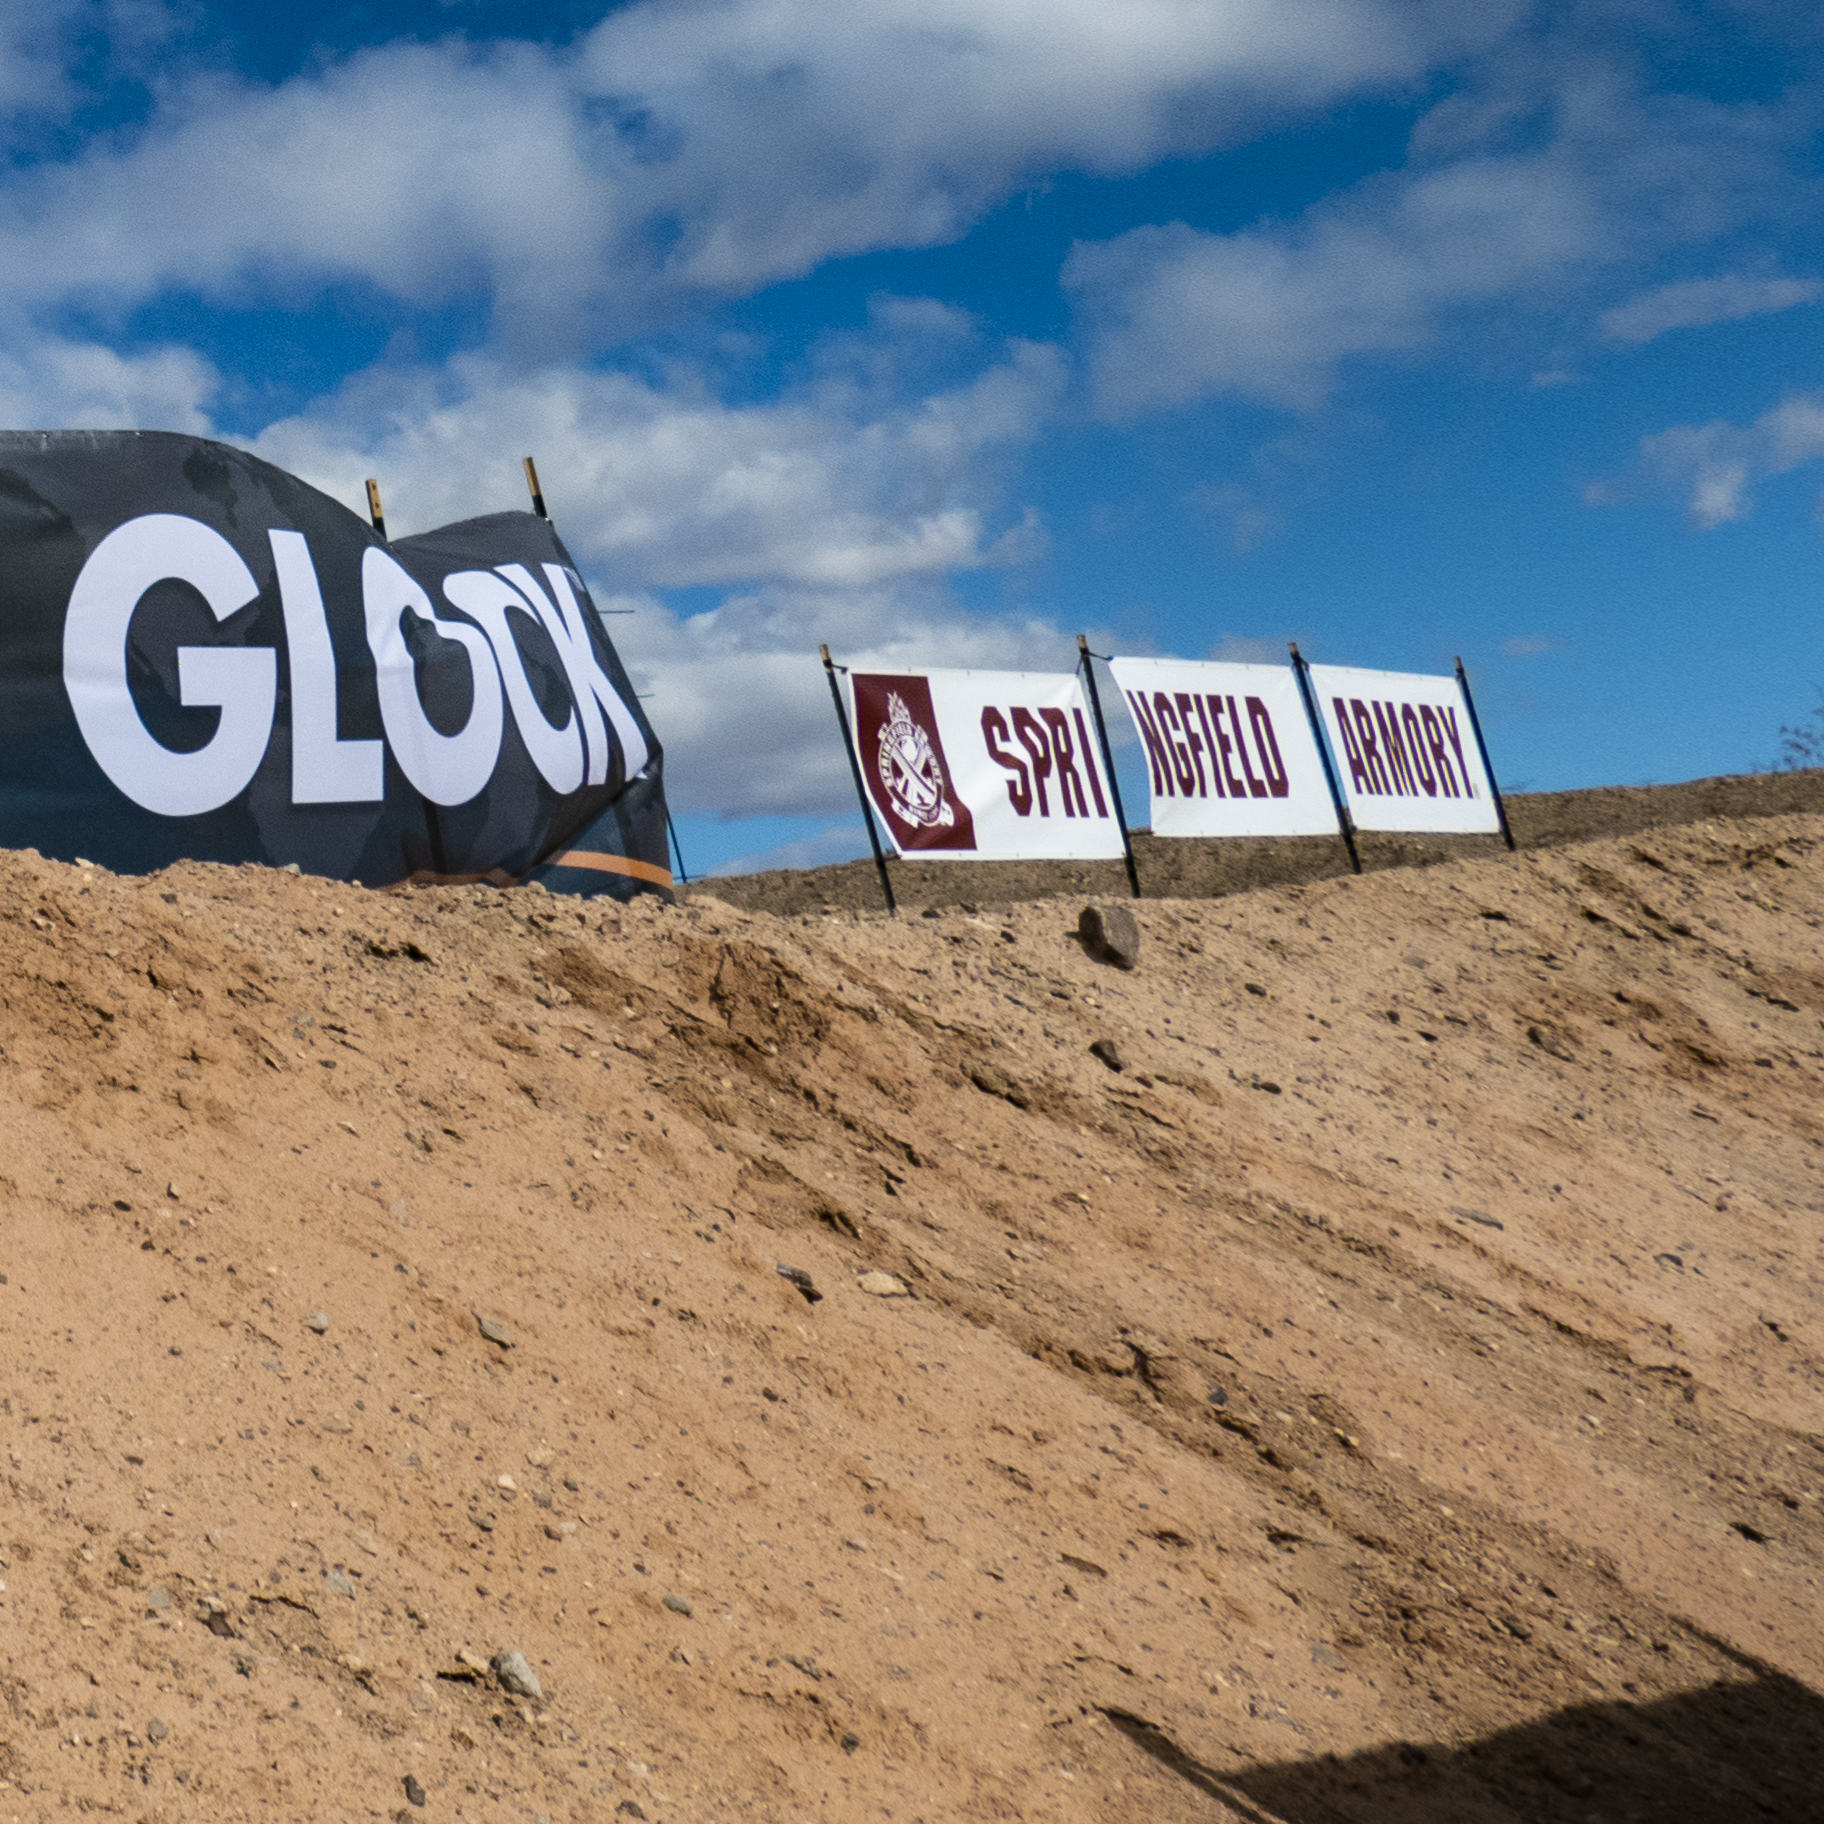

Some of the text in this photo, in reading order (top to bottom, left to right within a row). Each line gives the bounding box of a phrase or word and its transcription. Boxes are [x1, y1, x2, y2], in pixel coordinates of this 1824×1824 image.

[63, 513, 649, 818] GLOCK
[980, 704, 1110, 818] SPRI
[1125, 689, 1290, 798] NGFIELD
[1332, 696, 1475, 800] ARMORY
